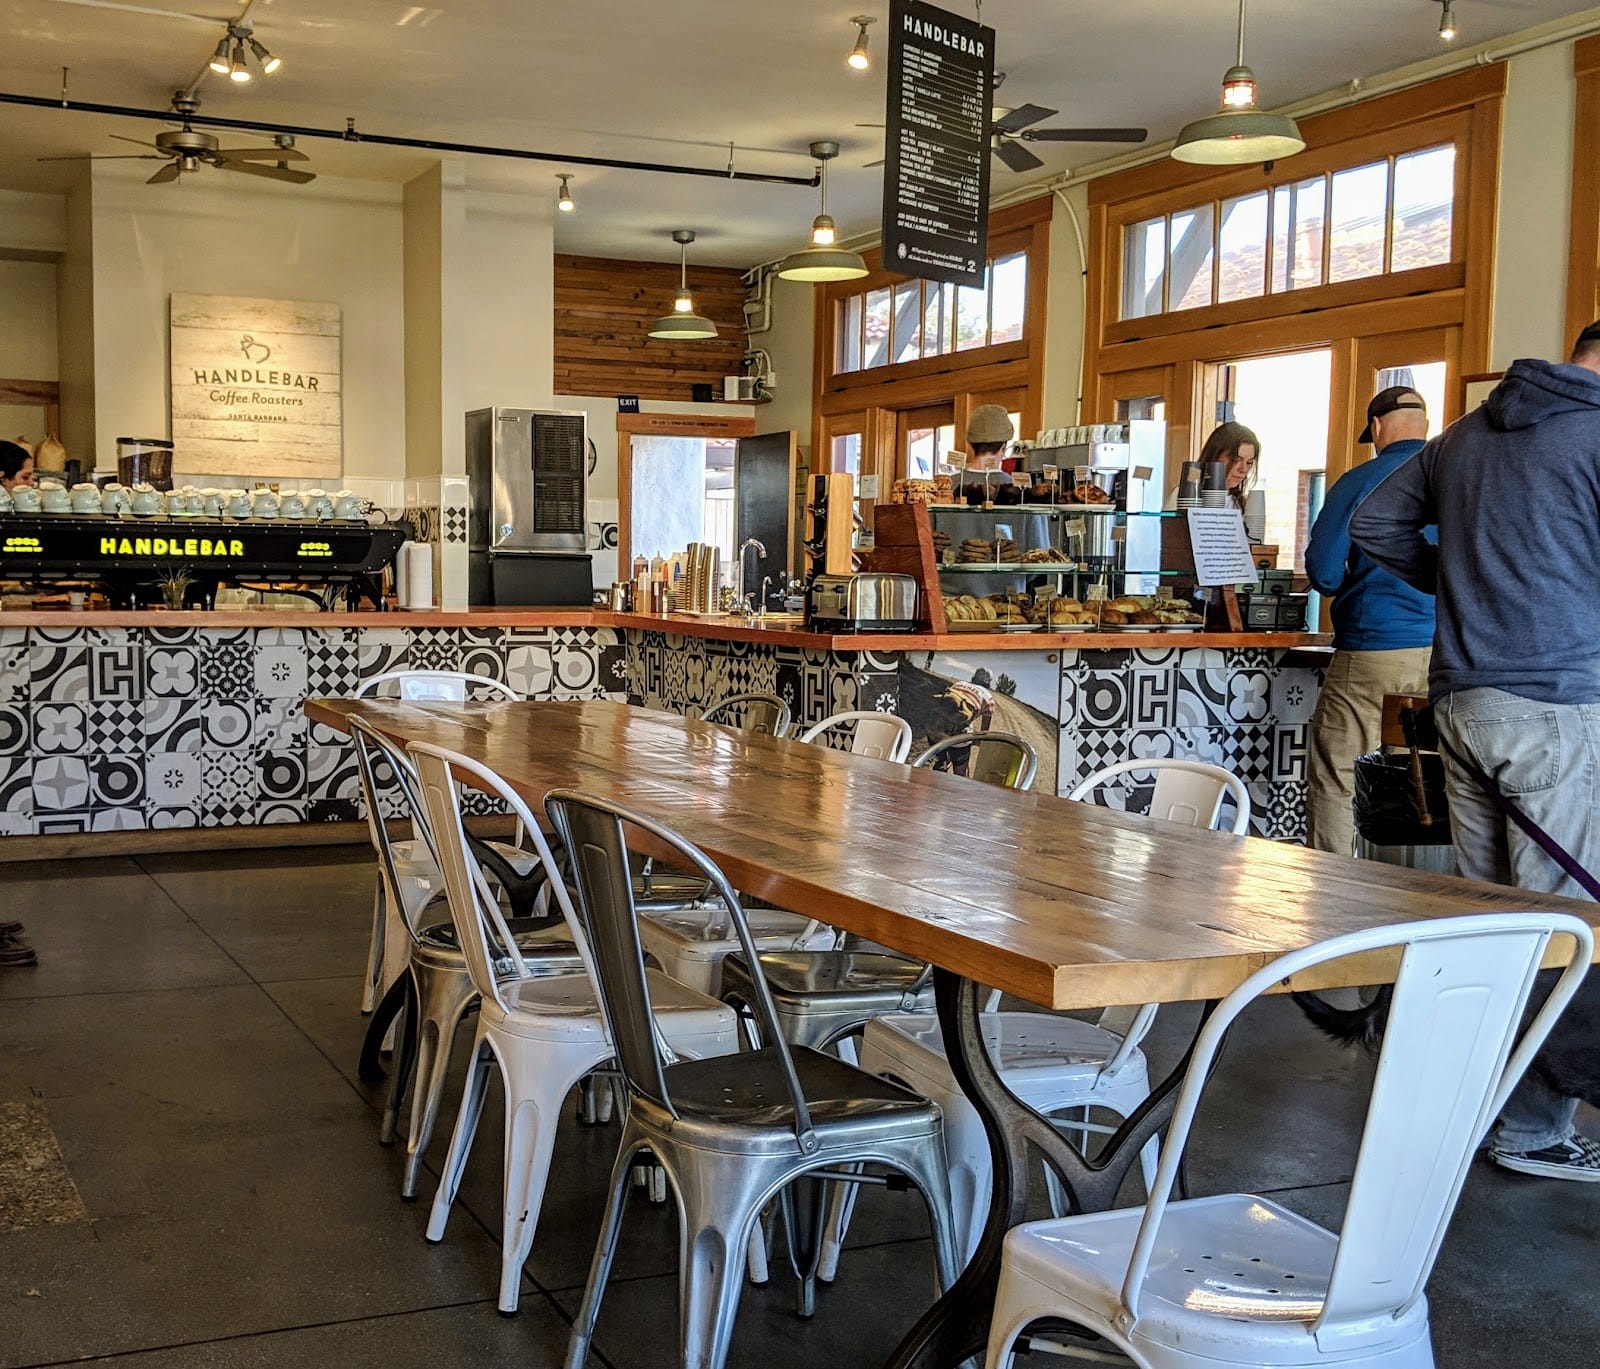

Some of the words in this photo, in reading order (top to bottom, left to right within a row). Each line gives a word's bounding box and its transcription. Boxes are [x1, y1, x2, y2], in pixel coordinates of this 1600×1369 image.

[904, 14, 984, 58] HANDLEBAR
[194, 369, 320, 391] HANDLEBAR
[210, 390, 248, 406] Coffee
[251, 393, 304, 406] Roasters
[620, 398, 638, 406] EXIT
[100, 538, 244, 556] HANDLEBAR
